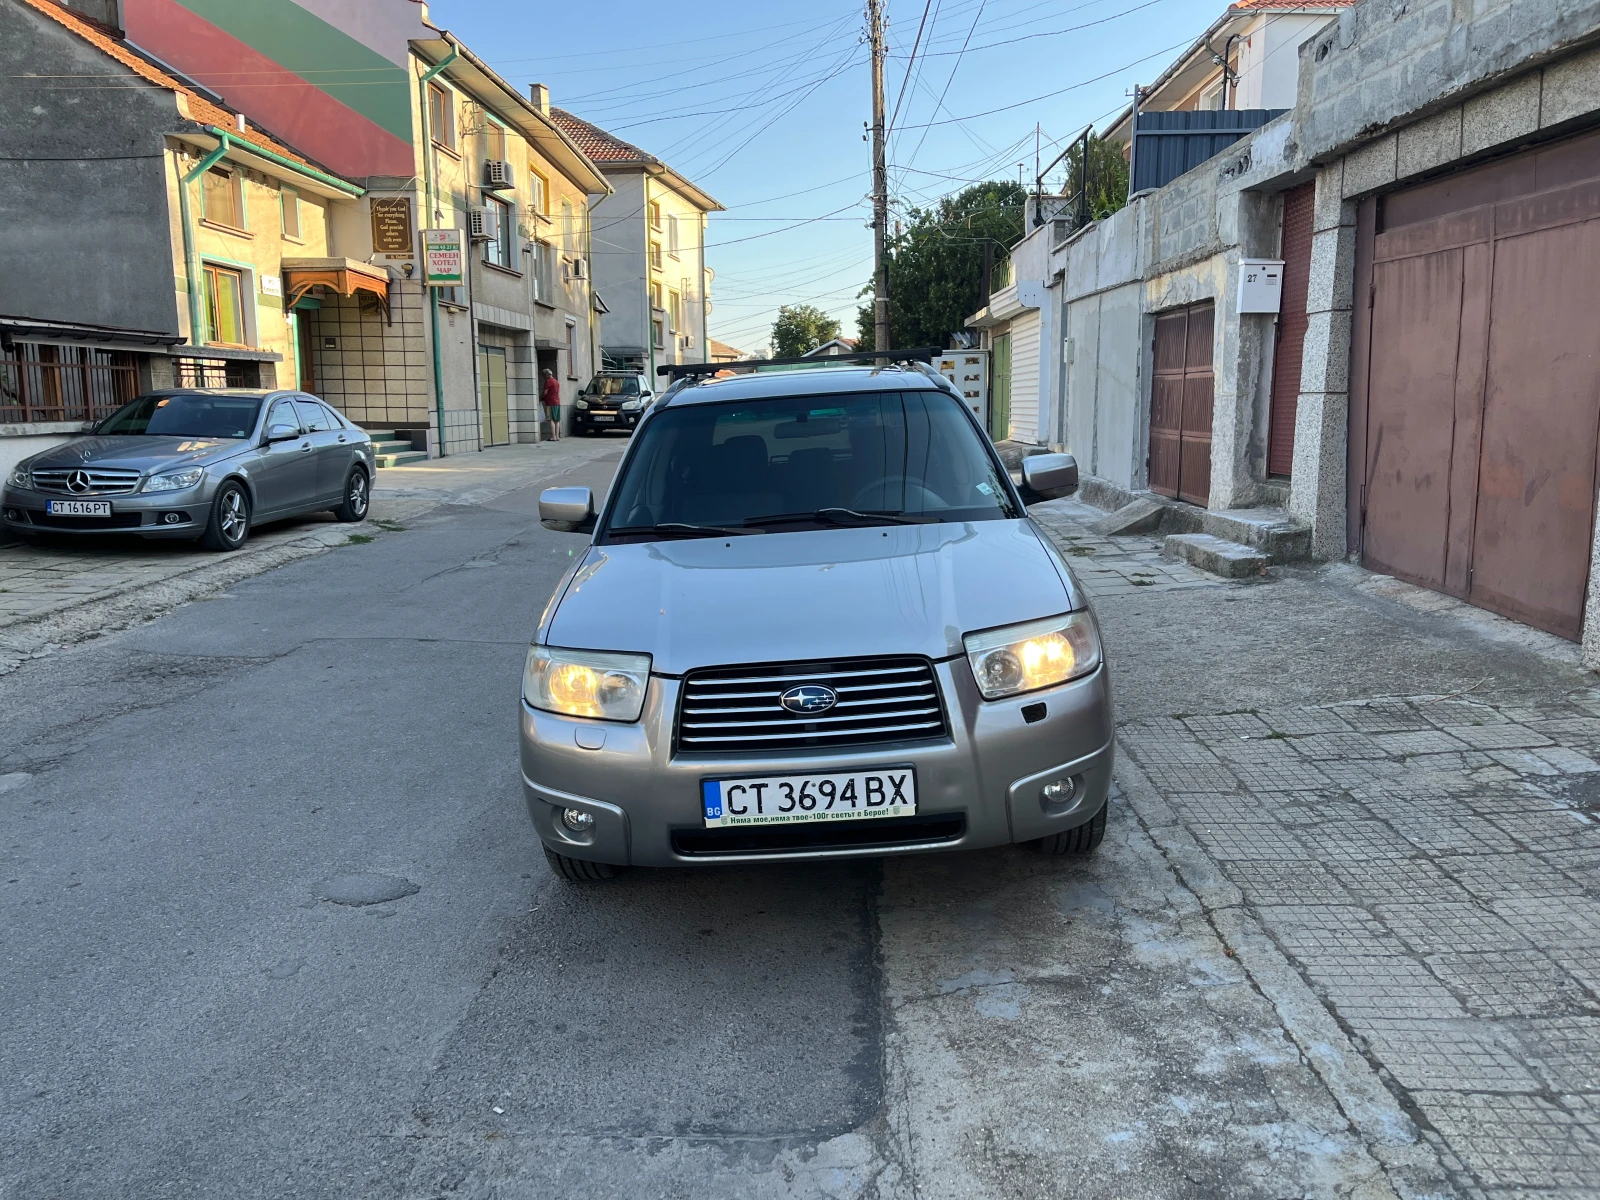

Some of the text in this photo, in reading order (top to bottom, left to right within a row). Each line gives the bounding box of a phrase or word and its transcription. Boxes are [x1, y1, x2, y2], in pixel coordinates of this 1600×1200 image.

[1247, 274, 1257, 283] 27
[52, 502, 108, 514] CT 1616 PT
[726, 774, 908, 815] CT 3694 BX
[706, 807, 721, 817] BG
[730, 816, 751, 825] Няма
[863, 807, 889, 817] Берое!
